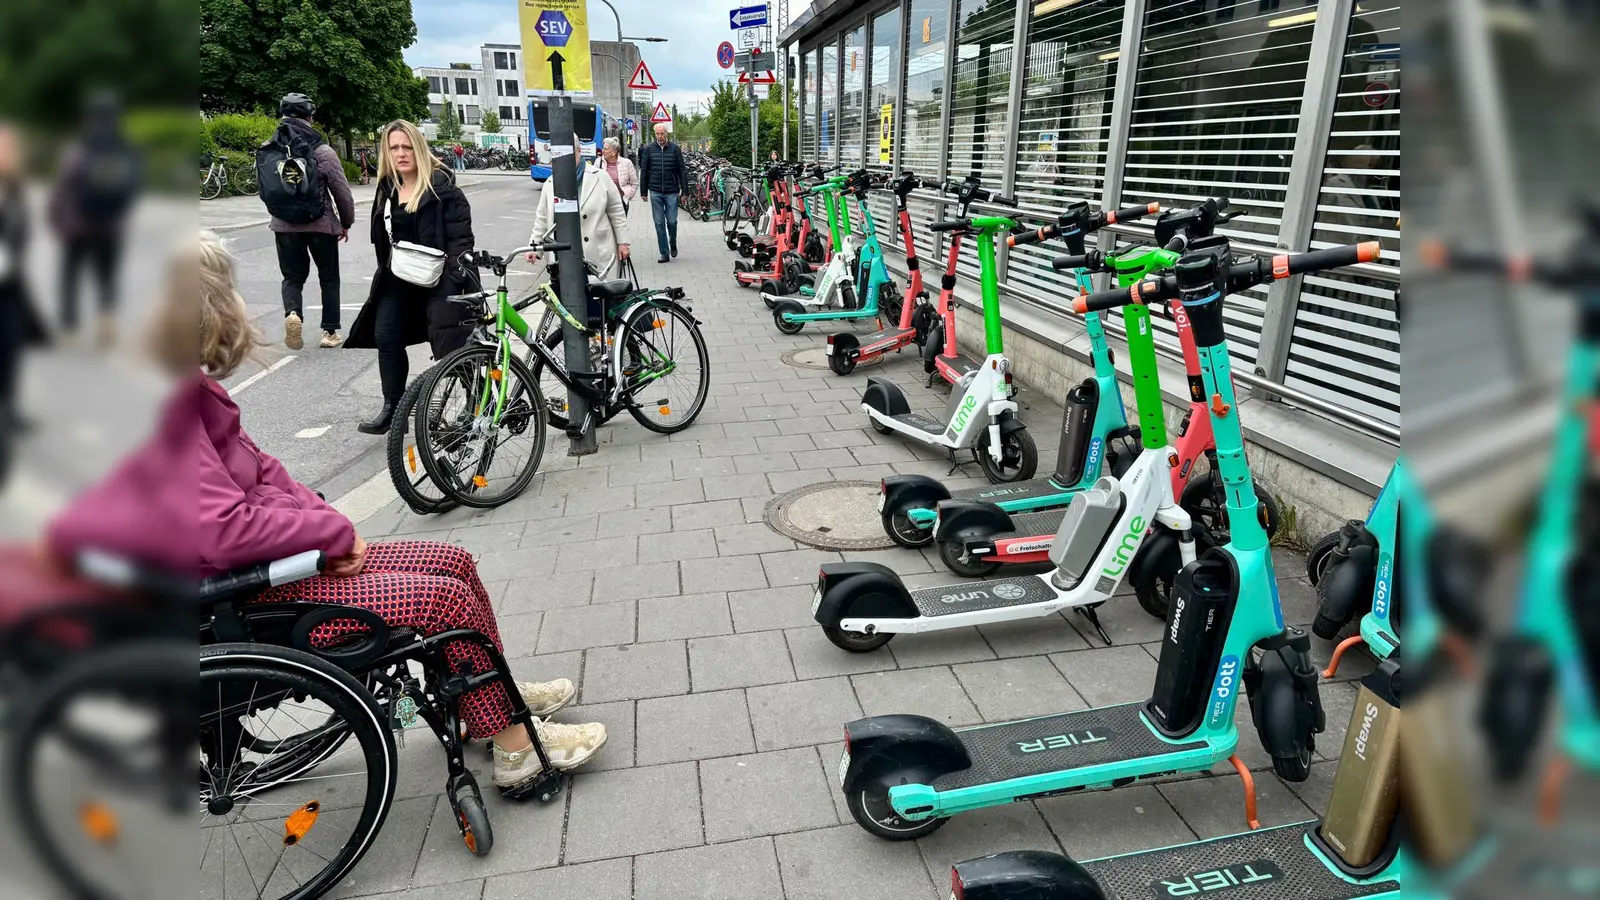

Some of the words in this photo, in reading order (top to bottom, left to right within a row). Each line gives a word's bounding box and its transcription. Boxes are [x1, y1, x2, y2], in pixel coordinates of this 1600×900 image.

[540, 20, 567, 34] SEV
[1173, 305, 1191, 332] voi.
[951, 395, 977, 432] Lime
[1090, 440, 1101, 464] dott
[1103, 515, 1146, 577] Lime
[940, 590, 990, 604] Lime
[1376, 580, 1388, 614] dott
[1170, 597, 1185, 644] Swap!
[1205, 608, 1215, 632] TIER
[1217, 661, 1236, 698] dott
[1212, 701, 1222, 724] TIER
[1016, 730, 1107, 753] TIER
[1354, 702, 1379, 762] Swap!
[1160, 864, 1273, 896] TIER
